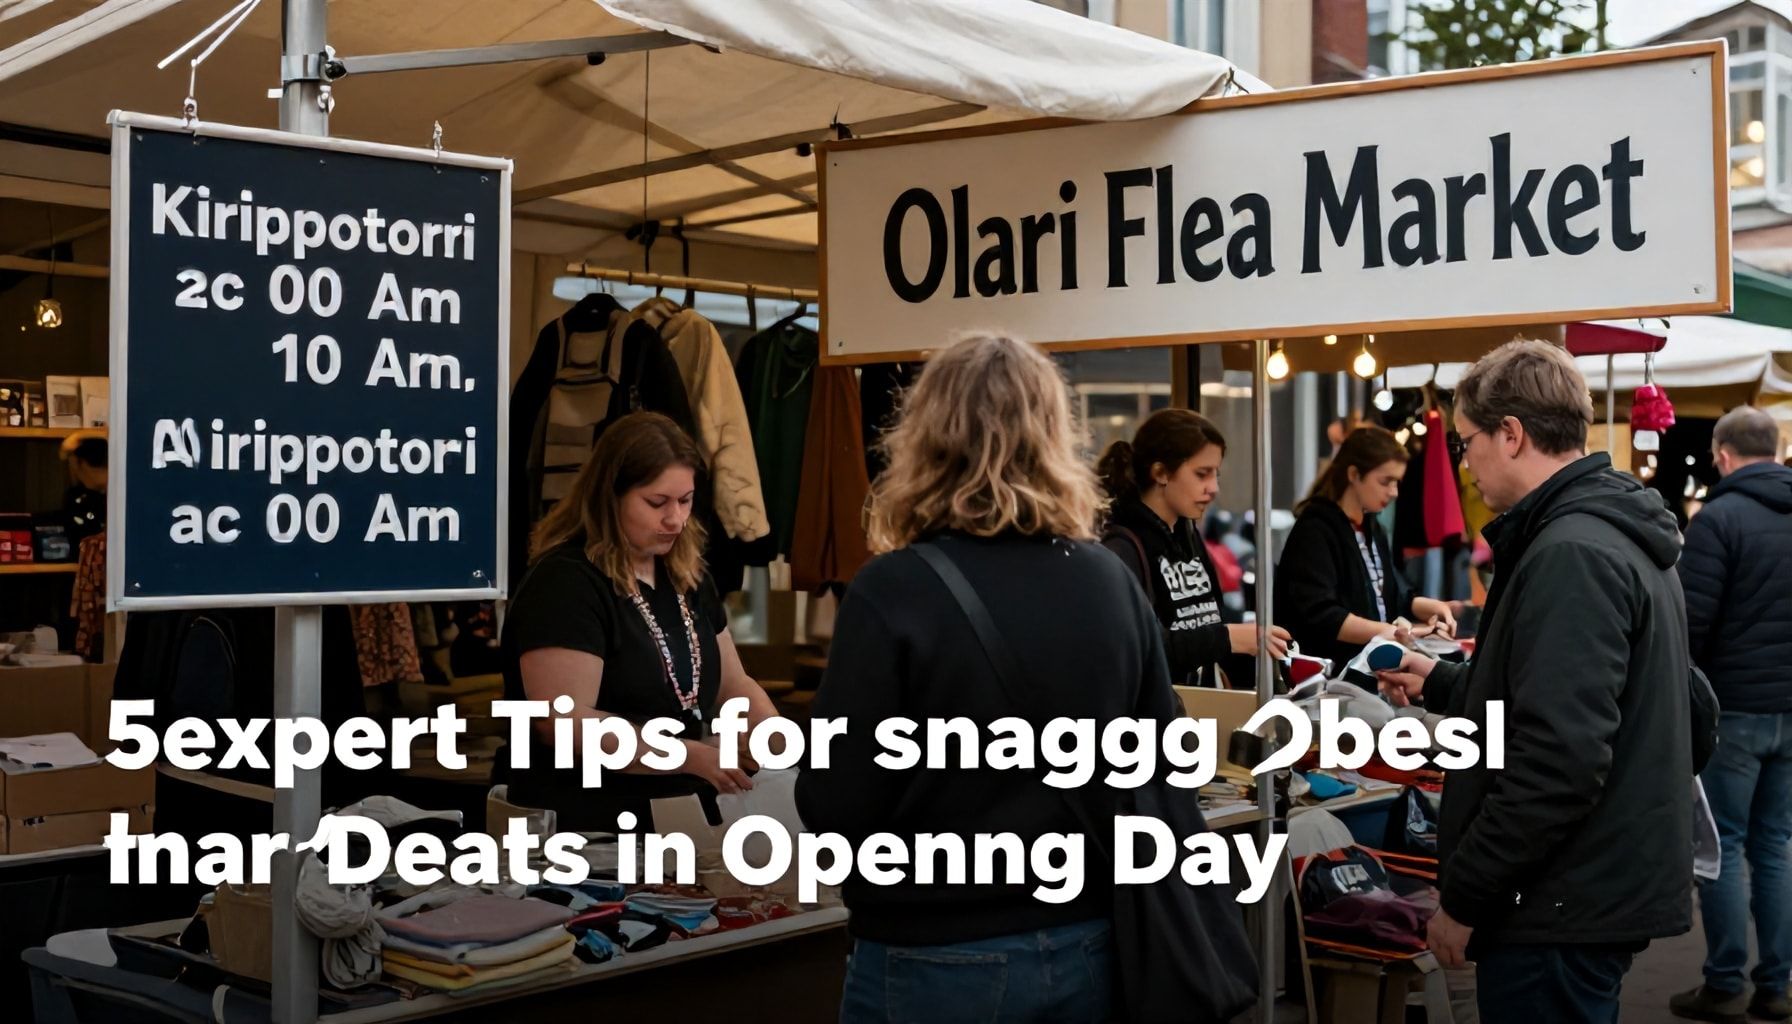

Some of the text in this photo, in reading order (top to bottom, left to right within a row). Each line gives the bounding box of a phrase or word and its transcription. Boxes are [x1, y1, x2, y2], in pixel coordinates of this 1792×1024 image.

[152, 182, 475, 260] Kirippotorri
[883, 132, 1647, 304] Olari Flea Market
[268, 264, 343, 318] 00
[367, 272, 461, 324] Am
[271, 333, 342, 385] 10
[169, 492, 460, 544] ac 00 Am
